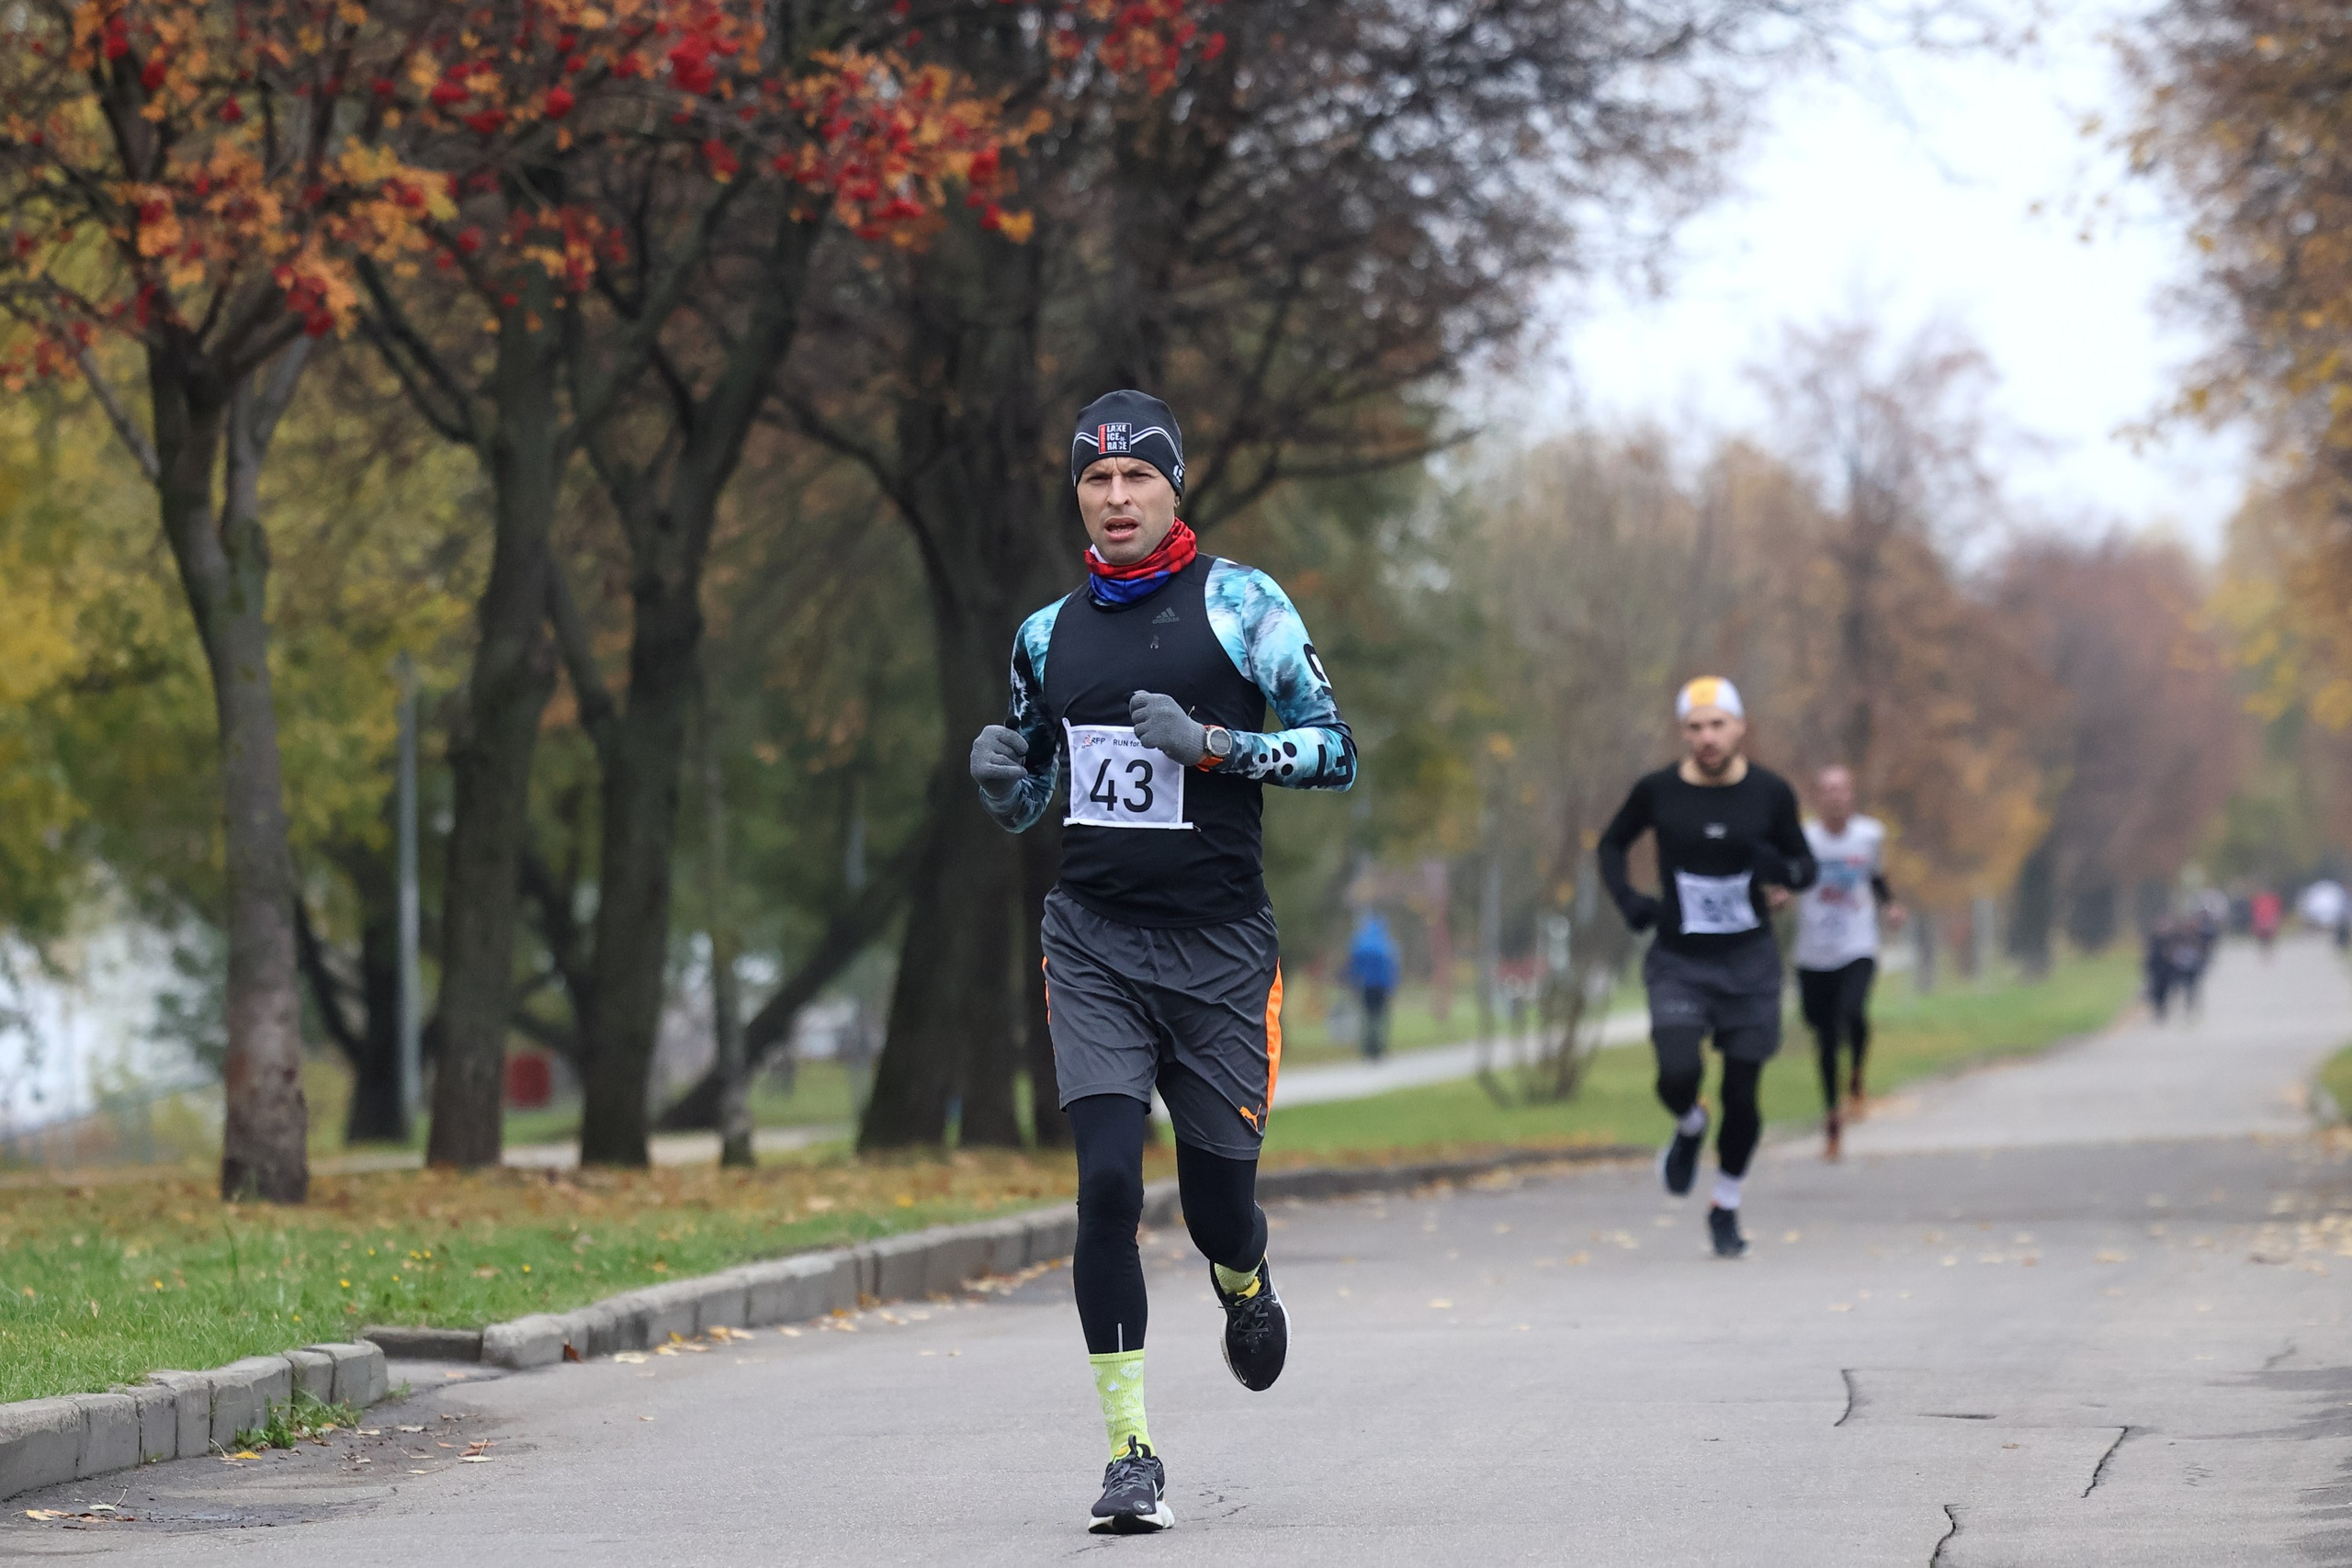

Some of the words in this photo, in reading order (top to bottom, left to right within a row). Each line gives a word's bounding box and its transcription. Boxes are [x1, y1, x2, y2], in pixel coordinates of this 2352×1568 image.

[1106, 424, 1126, 433] LAKE
[1106, 433, 1120, 441] ICE
[1106, 442, 1126, 450] RACE
[1113, 739, 1128, 747] RUN
[1090, 758, 1154, 813] 43
